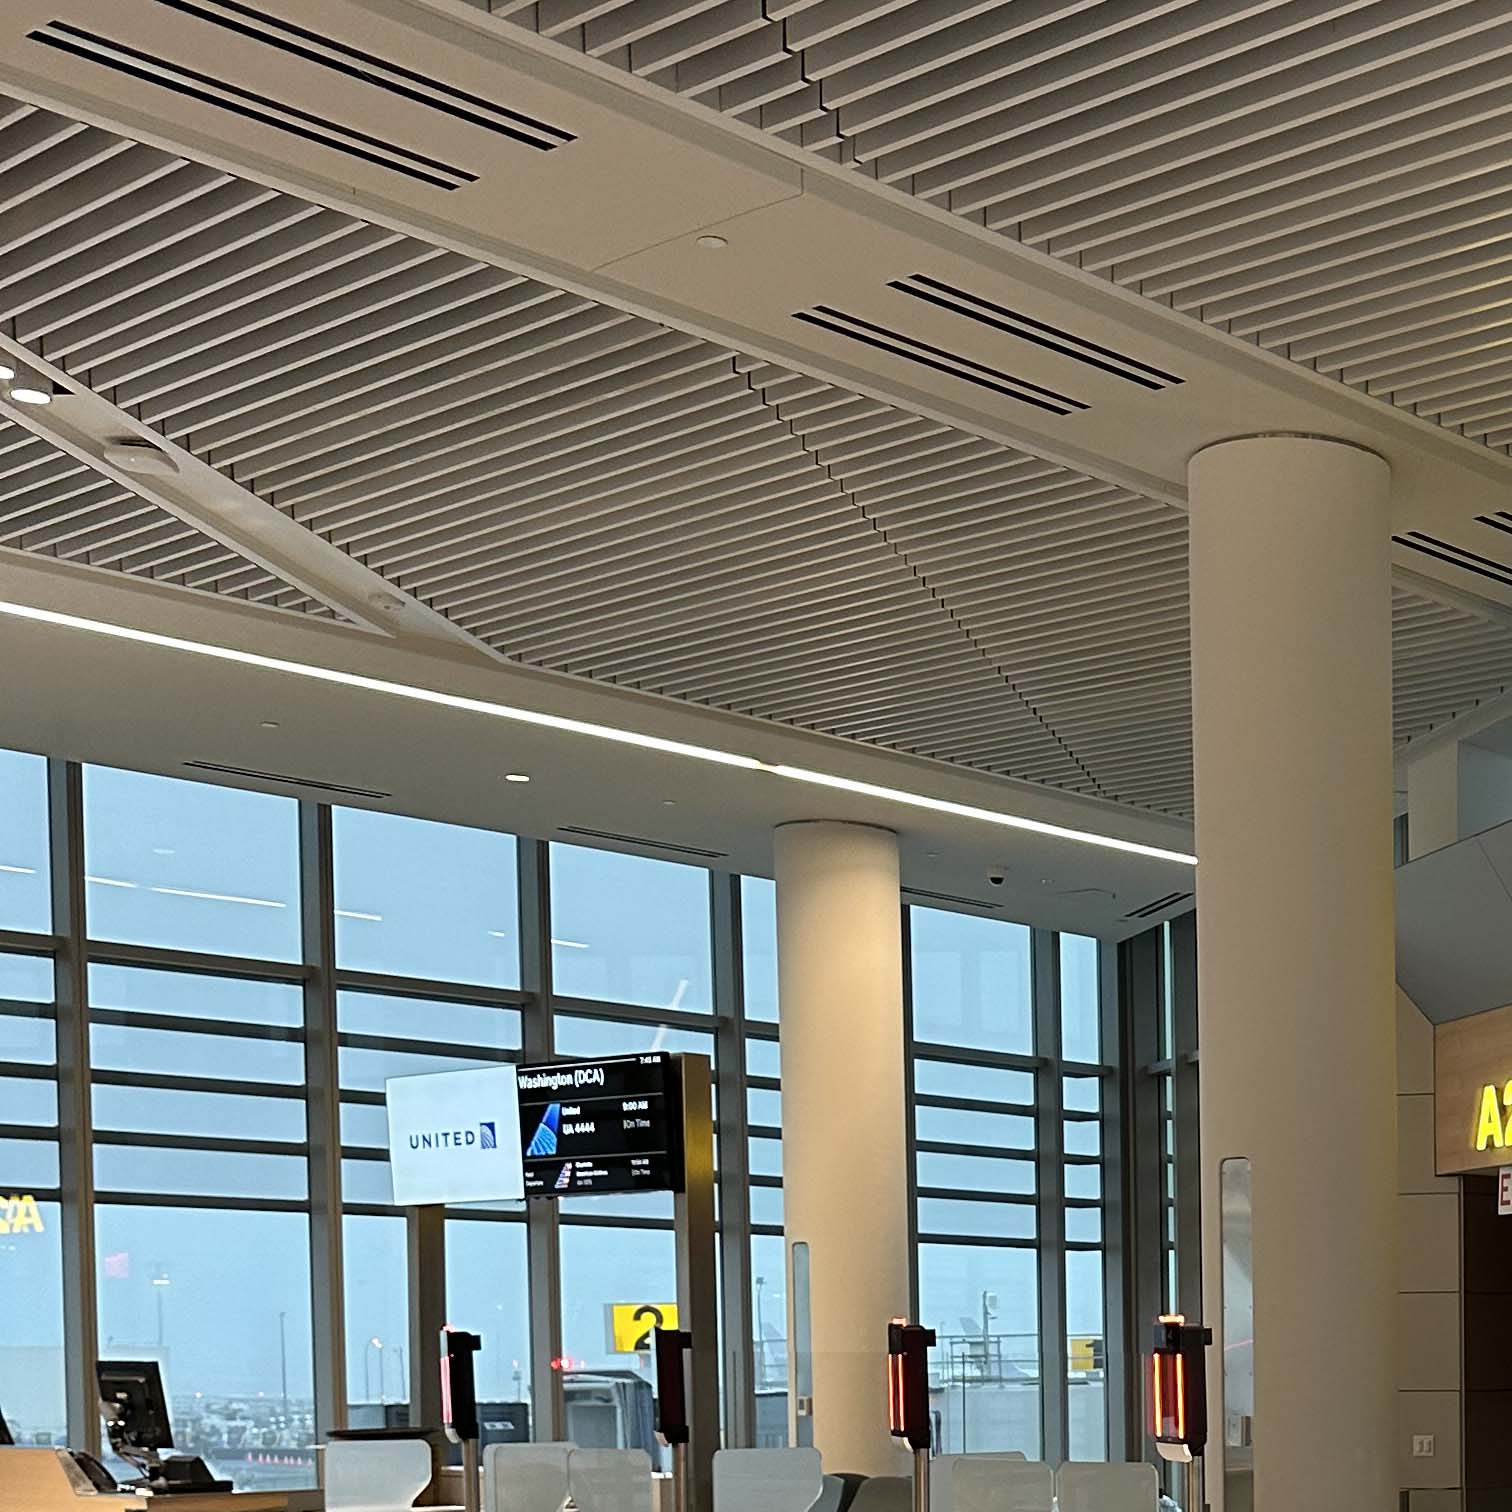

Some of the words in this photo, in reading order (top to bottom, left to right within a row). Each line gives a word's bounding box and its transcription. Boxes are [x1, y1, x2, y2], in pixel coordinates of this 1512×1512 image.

[518, 1072, 573, 1090] Washington
[574, 1068, 605, 1088] (DCA)
[410, 1131, 475, 1149] UNITED
